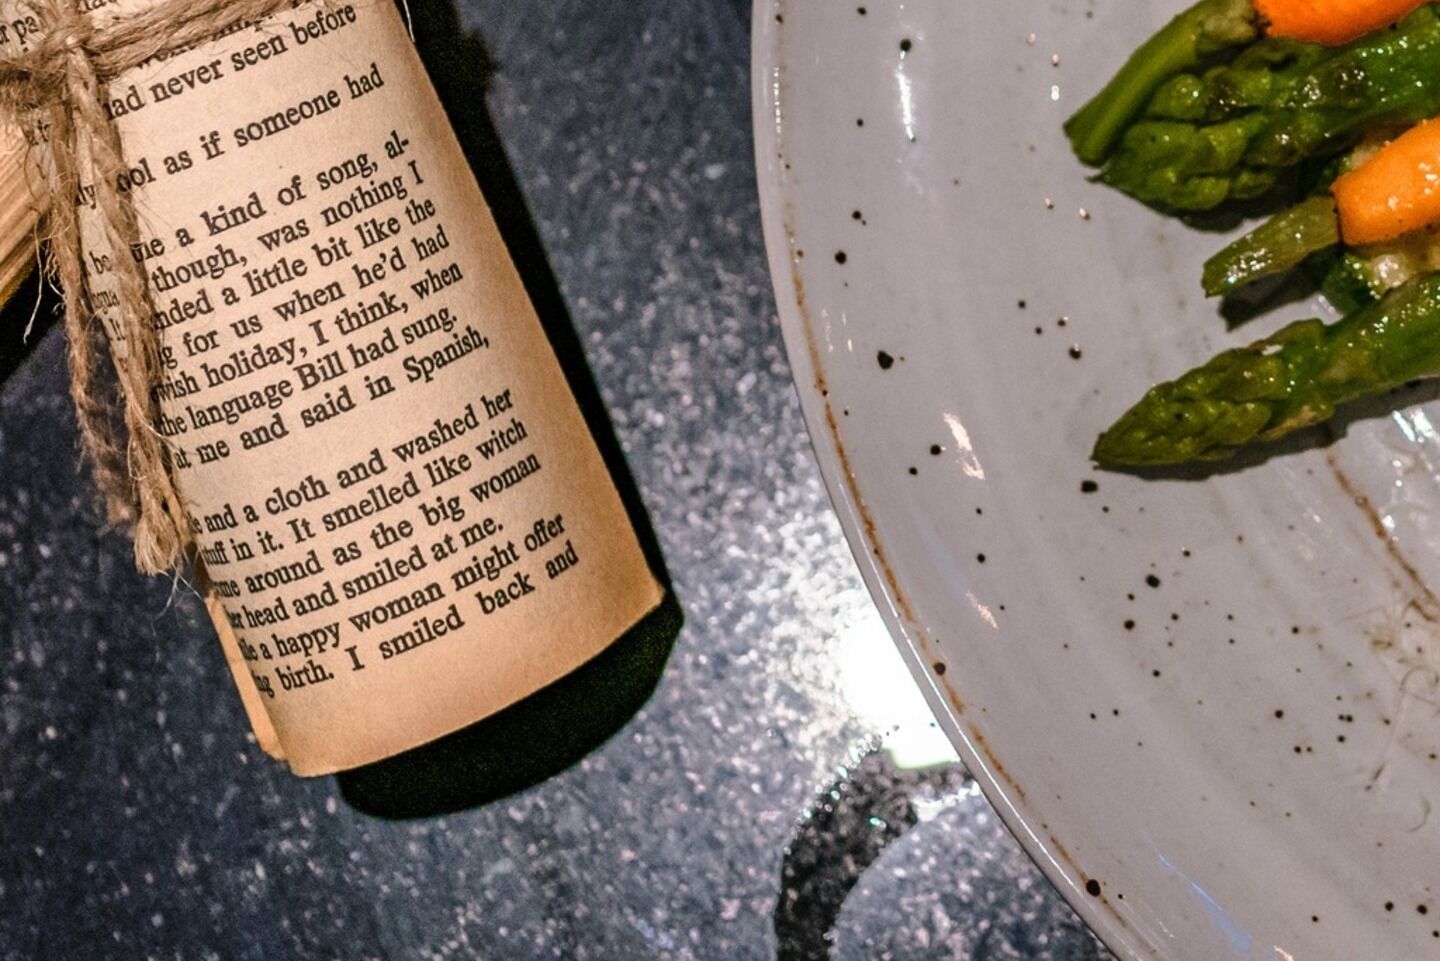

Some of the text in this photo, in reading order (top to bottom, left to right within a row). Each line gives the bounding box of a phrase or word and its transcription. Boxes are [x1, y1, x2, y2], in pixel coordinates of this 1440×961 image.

[149, 57, 222, 104] never
[231, 32, 288, 73] seen
[288, 2, 357, 46] before
[164, 150, 193, 175] as
[200, 130, 225, 160] if
[234, 89, 341, 148] someone
[344, 62, 385, 99] had
[152, 160, 424, 293] though, was nothing I
[175, 227, 194, 248] a
[200, 192, 266, 237] kind
[277, 175, 306, 206] of
[316, 153, 378, 192] song,
[385, 130, 409, 160] al-
[221, 286, 240, 306] a
[244, 257, 308, 297] little
[312, 235, 352, 267] bit
[355, 216, 400, 249] like
[405, 197, 436, 226] the
[183, 329, 221, 357] for
[230, 315, 263, 338] us
[273, 281, 346, 322] when
[411, 224, 450, 261] had
[200, 337, 308, 388] holiday,
[308, 319, 330, 347] I
[334, 291, 408, 336] think,
[411, 262, 464, 302] when
[175, 325, 489, 470] at me and said in Spanish,
[185, 379, 293, 430] language
[294, 351, 347, 391] Bill
[347, 326, 399, 369] had
[401, 307, 457, 345] sung.
[204, 503, 239, 533] and
[243, 504, 260, 523] a
[265, 474, 330, 515] cloth
[336, 447, 388, 489] and
[392, 403, 480, 464] washed
[480, 388, 513, 419] her
[230, 538, 255, 562] in
[256, 530, 284, 555] it.
[286, 517, 316, 544] It
[322, 471, 421, 533] smelled
[423, 451, 472, 488] like
[475, 416, 528, 461] witch
[244, 549, 324, 594] around
[332, 541, 362, 566] as
[370, 518, 414, 550] the
[419, 494, 465, 527] big
[469, 452, 542, 504] woman
[241, 596, 290, 628] head
[292, 580, 339, 617] and
[342, 544, 428, 600] smiled
[430, 533, 458, 562] at
[459, 517, 504, 548] me.
[260, 641, 273, 660] a
[271, 622, 340, 657] happy
[348, 581, 446, 632] woman
[451, 540, 519, 591] might
[523, 513, 566, 553] offer
[275, 660, 334, 691] birth.
[344, 645, 365, 672] I
[379, 603, 465, 660] smiled
[475, 571, 535, 616] back
[545, 540, 579, 579] and
